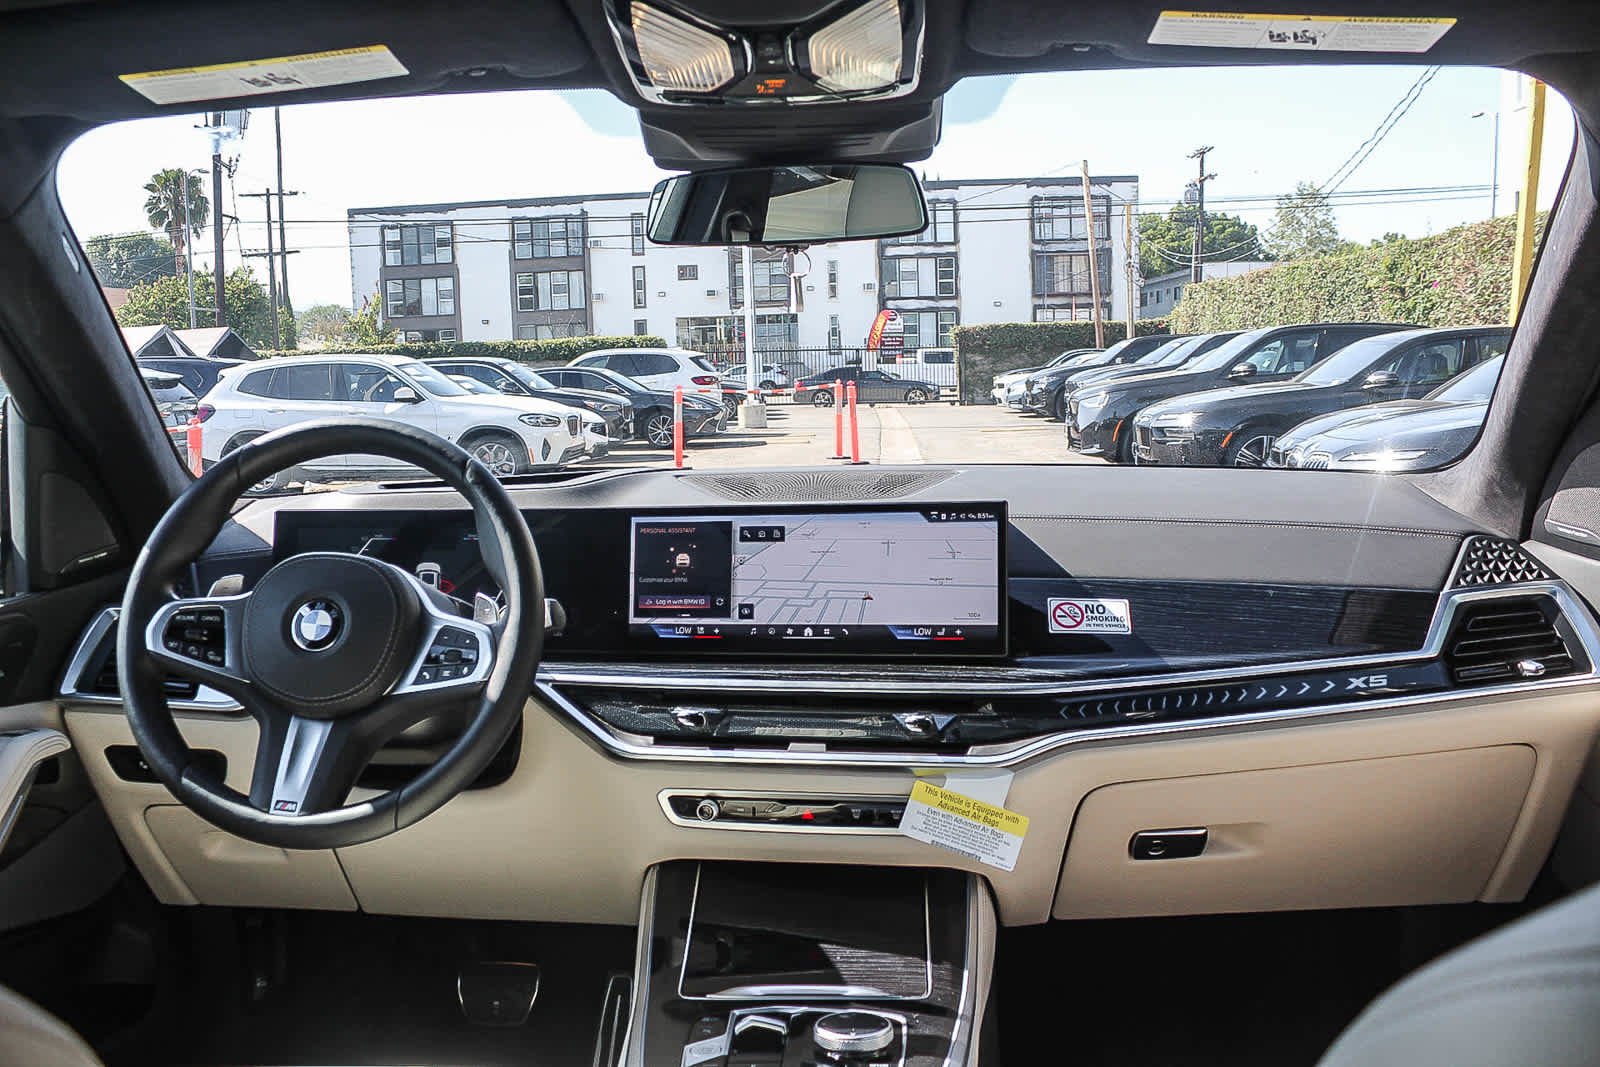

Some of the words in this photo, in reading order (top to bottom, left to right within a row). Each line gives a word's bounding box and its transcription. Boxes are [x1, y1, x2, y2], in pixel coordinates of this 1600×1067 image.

[1084, 604, 1106, 615] NO
[1085, 615, 1126, 623] SMOKING
[675, 626, 692, 635] LOW
[913, 627, 932, 636] LOW
[1345, 674, 1388, 690] X5
[925, 785, 938, 797] This
[940, 792, 964, 805] Vehicle
[965, 799, 972, 808] is
[972, 802, 1003, 819] Equipped
[1005, 814, 1020, 825] with
[936, 801, 970, 817] Advanced
[971, 812, 982, 821] Air
[982, 816, 1000, 827] Bags
[927, 807, 940, 817] Even
[941, 813, 954, 821] with
[954, 816, 981, 831] Advanced
[990, 829, 1005, 840] Bags
